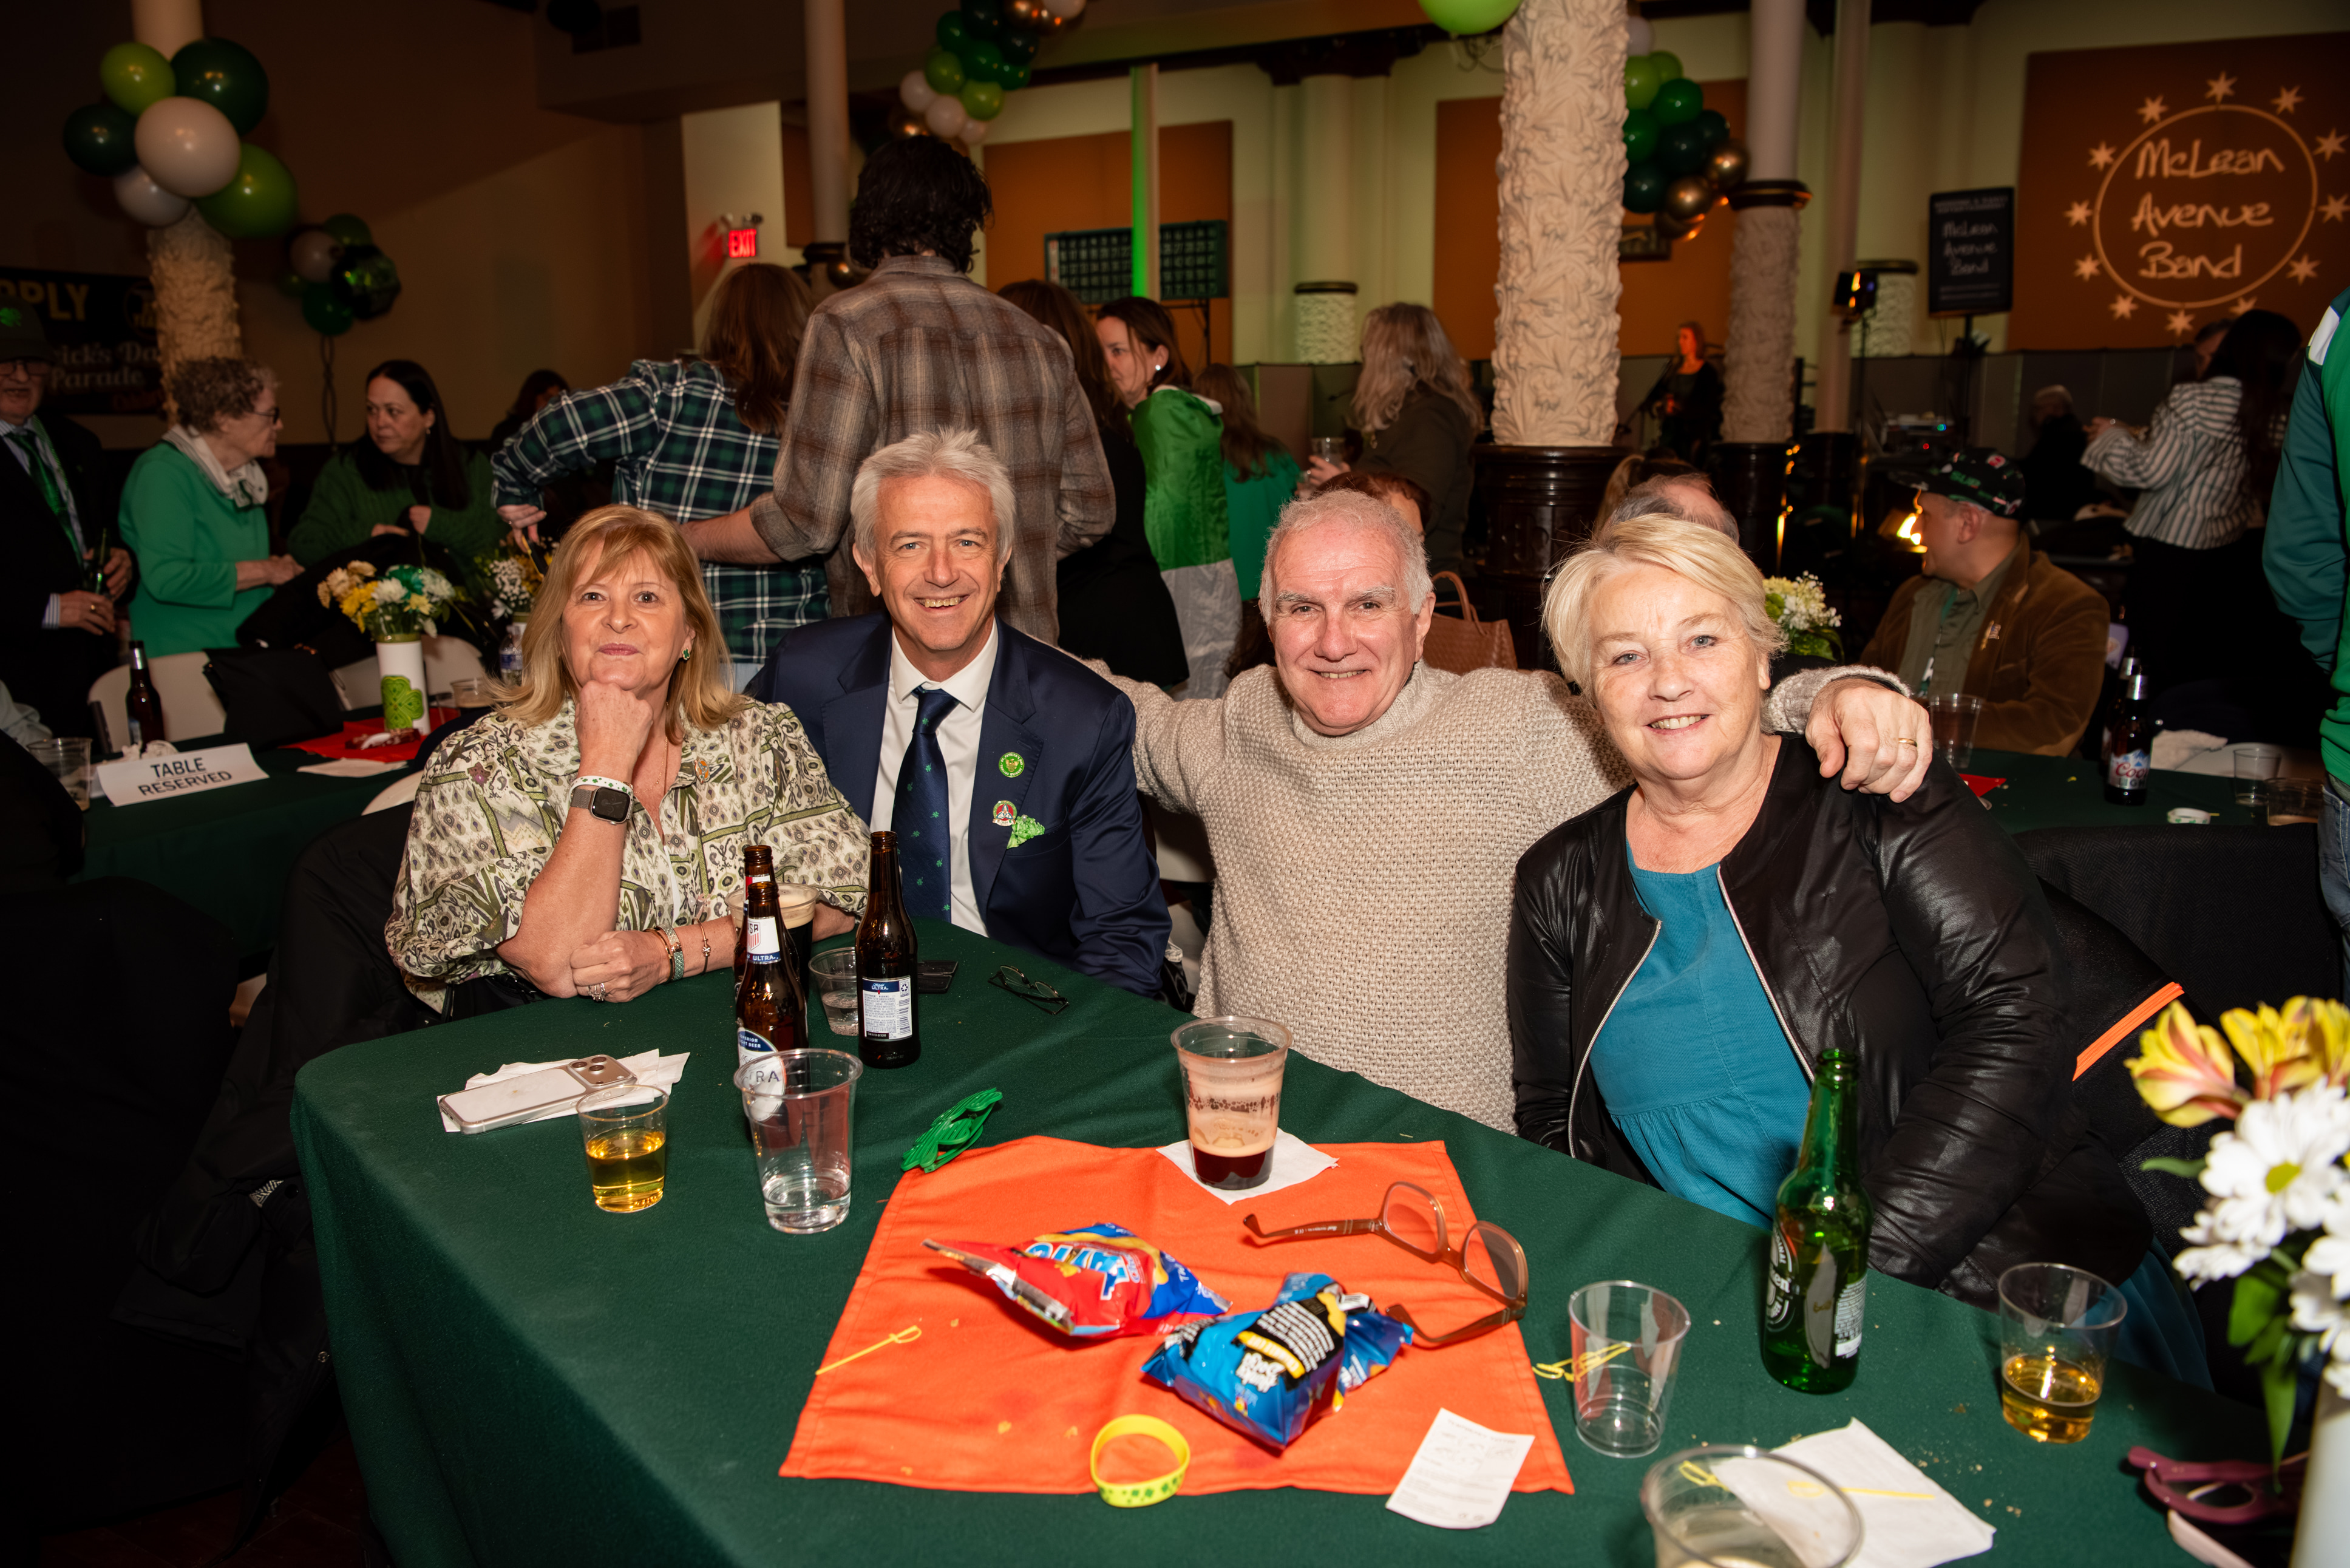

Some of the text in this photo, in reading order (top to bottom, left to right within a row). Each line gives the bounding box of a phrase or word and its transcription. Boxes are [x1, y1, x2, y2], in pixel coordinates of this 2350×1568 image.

[2135, 137, 2285, 179] McLean
[2131, 191, 2274, 237] Avenue
[730, 230, 756, 257] EXIT
[2138, 240, 2242, 279] Band
[54, 341, 114, 365] ick's
[50, 365, 146, 392] Parade
[151, 758, 206, 778] TABLE
[138, 770, 232, 795] RESERVED
